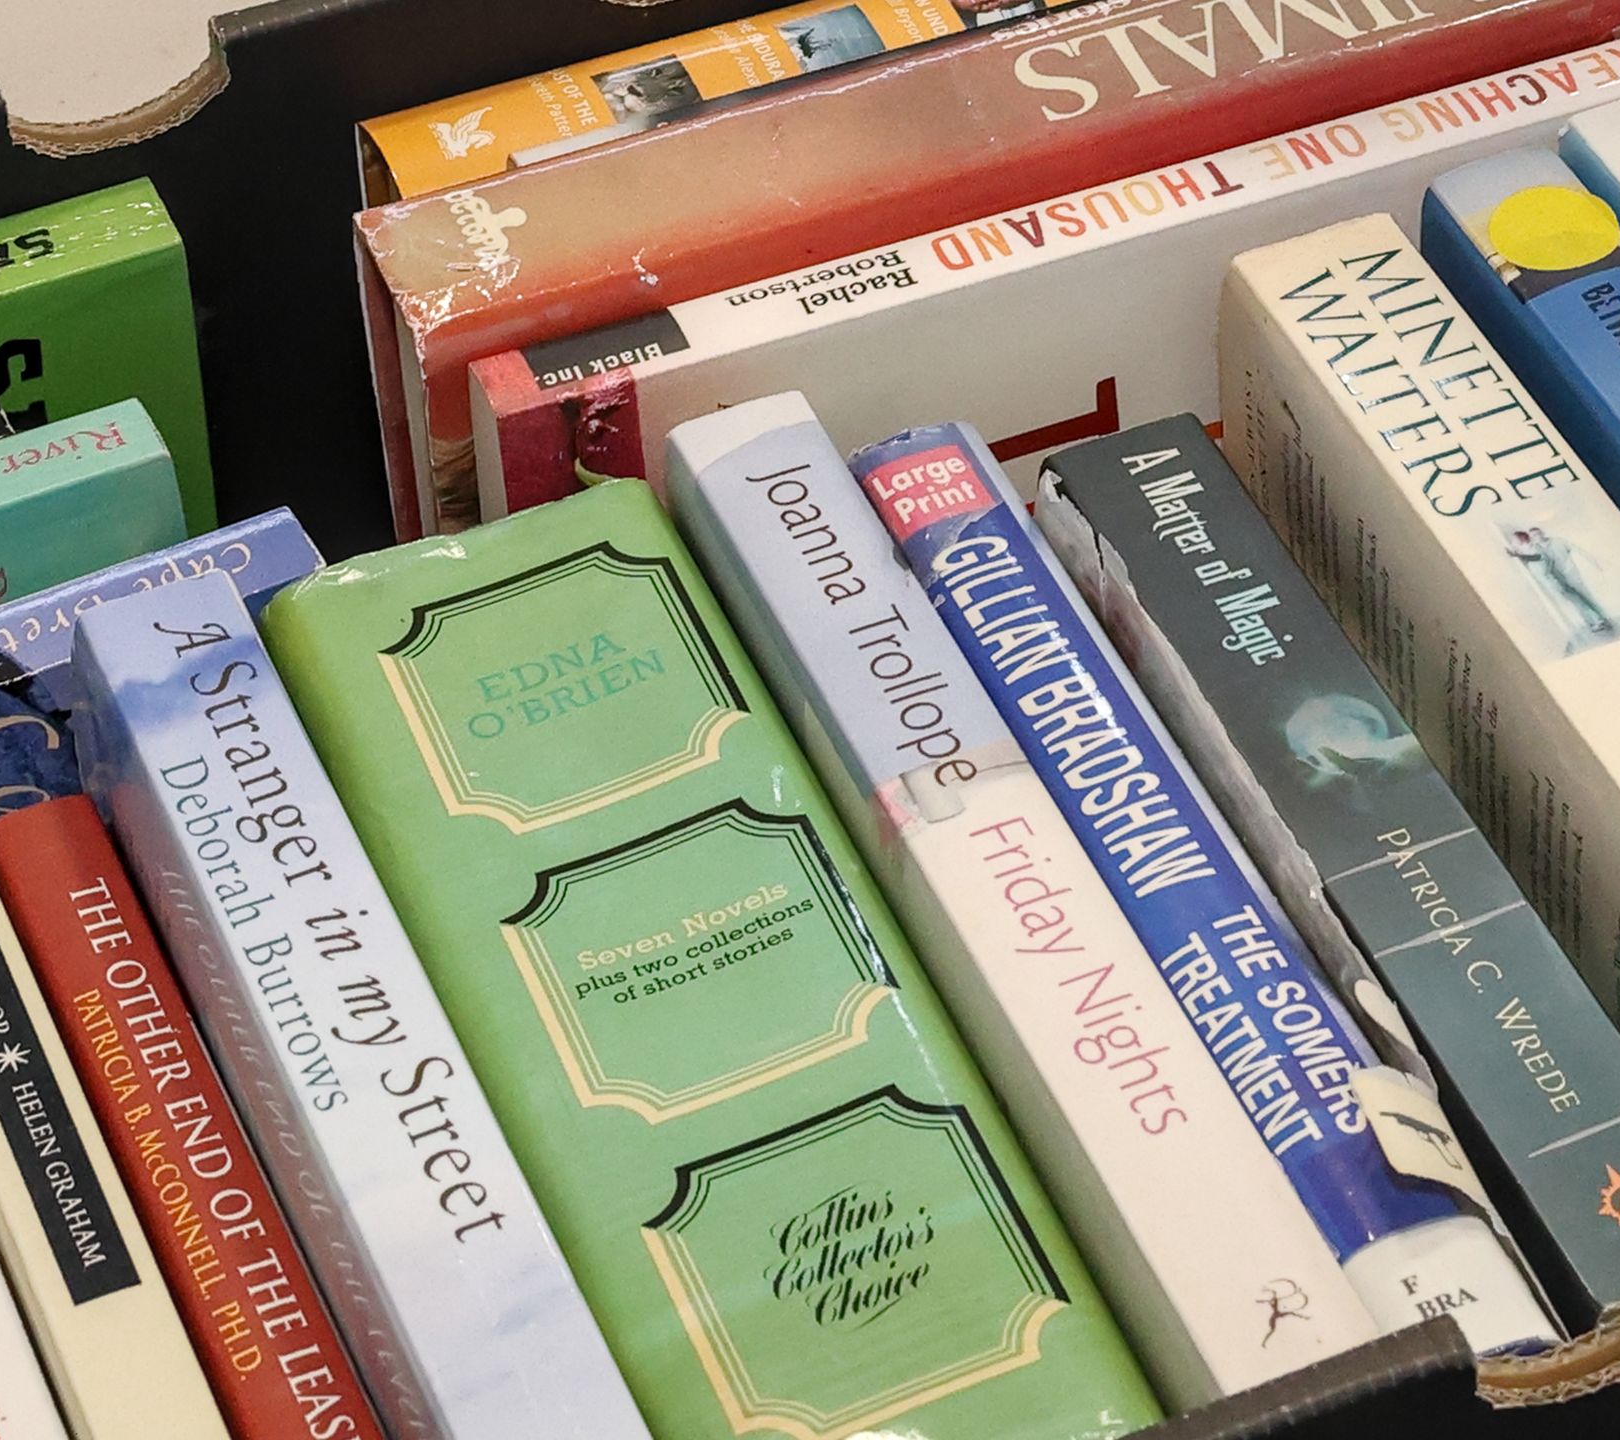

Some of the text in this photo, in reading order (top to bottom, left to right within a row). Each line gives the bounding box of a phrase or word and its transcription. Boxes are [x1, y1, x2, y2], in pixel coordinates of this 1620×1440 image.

[1266, 123, 1367, 182] ONE
[931, 159, 1244, 272] THOUSAND
[727, 247, 908, 309] Robertson
[799, 266, 919, 317] Rachel
[1279, 266, 1503, 520] WALTERS
[1341, 247, 1581, 501] MINETTE
[872, 449, 969, 506] Large
[890, 477, 978, 527] Print
[474, 629, 630, 706] EDNA
[746, 462, 978, 790] Joanna Trollope
[466, 646, 669, 744] O'BRIEN
[930, 534, 1217, 900] GILLIAN BRADSHAW
[153, 618, 507, 1246] A Stranger in my Street
[159, 753, 277, 933] Deborah
[243, 933, 350, 1115] Burrows
[573, 895, 816, 1003] plus two collections
[575, 878, 791, 973] Seven Novels
[612, 925, 795, 1008] of short stories
[967, 814, 1188, 1136] Friday Nights
[1158, 932, 1325, 1159] TREATMENT
[1212, 904, 1367, 1136] THE SOMERS
[10, 1079, 54, 1159] HELEN
[40, 1157, 108, 1271] GRAHAM
